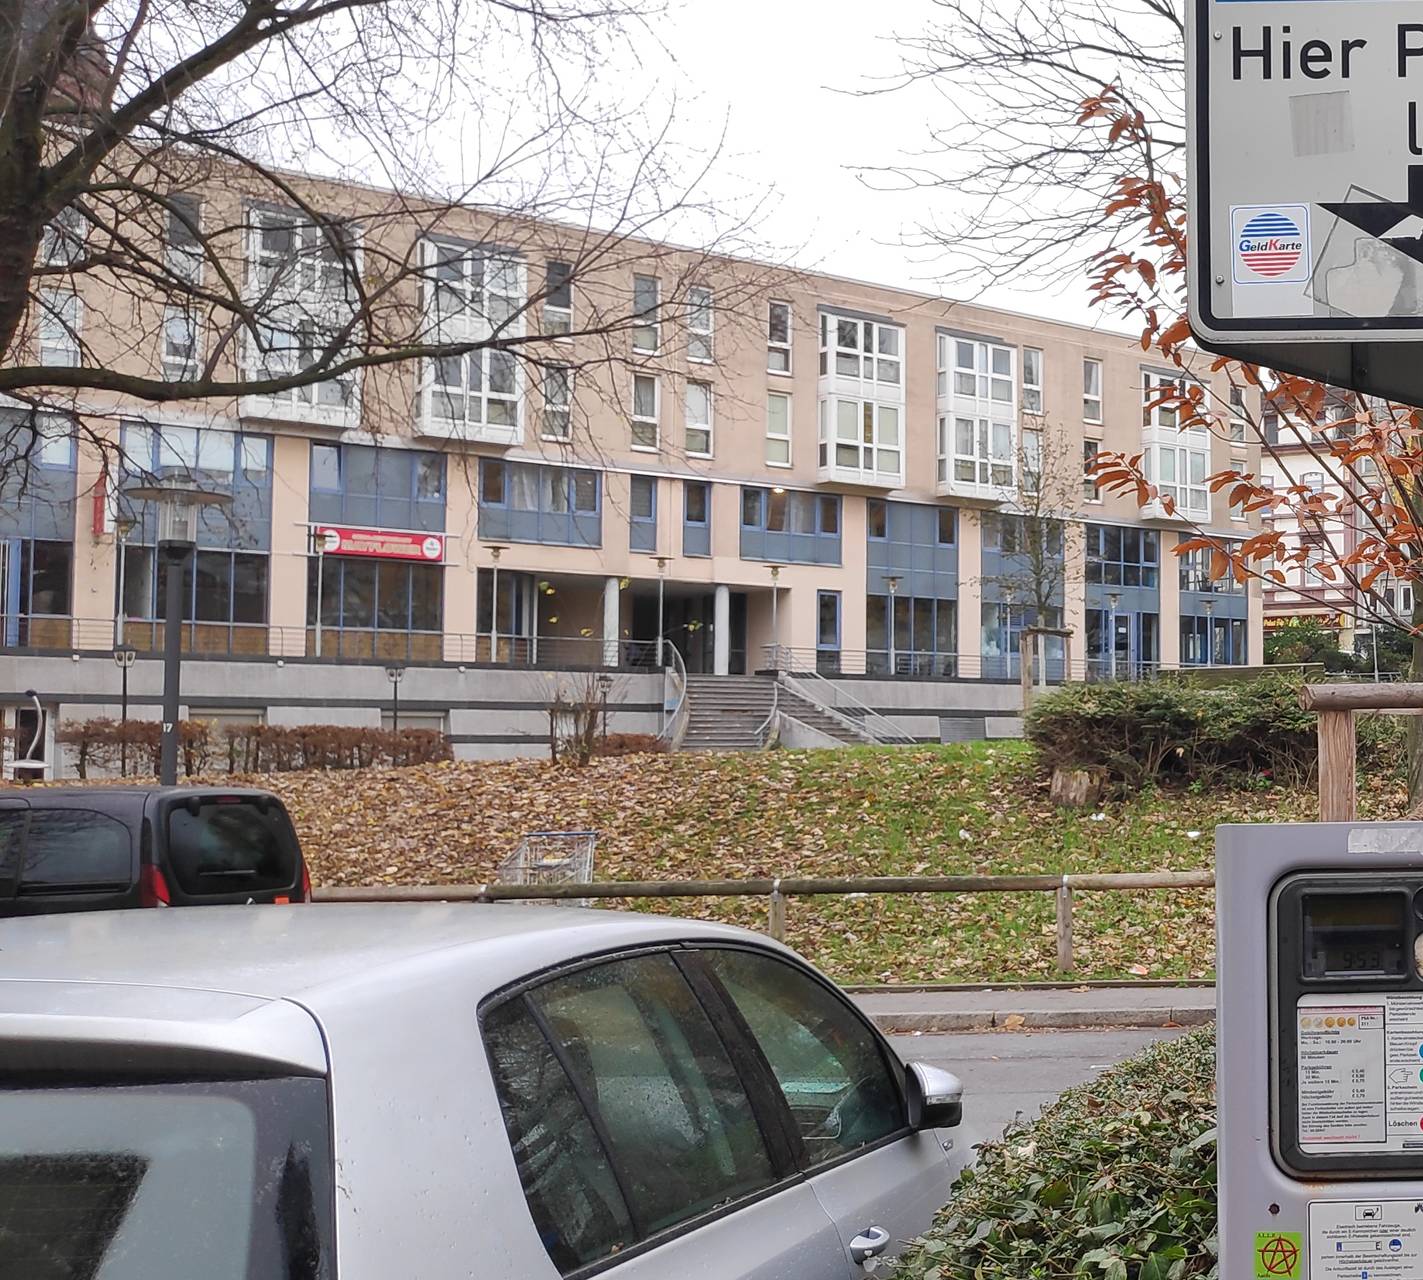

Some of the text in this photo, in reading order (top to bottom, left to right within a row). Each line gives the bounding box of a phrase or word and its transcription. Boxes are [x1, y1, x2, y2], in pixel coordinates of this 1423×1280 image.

[1232, 25, 1368, 80] Hier
[1239, 239, 1302, 252] GeldKarte
[163, 723, 173, 733] 17
